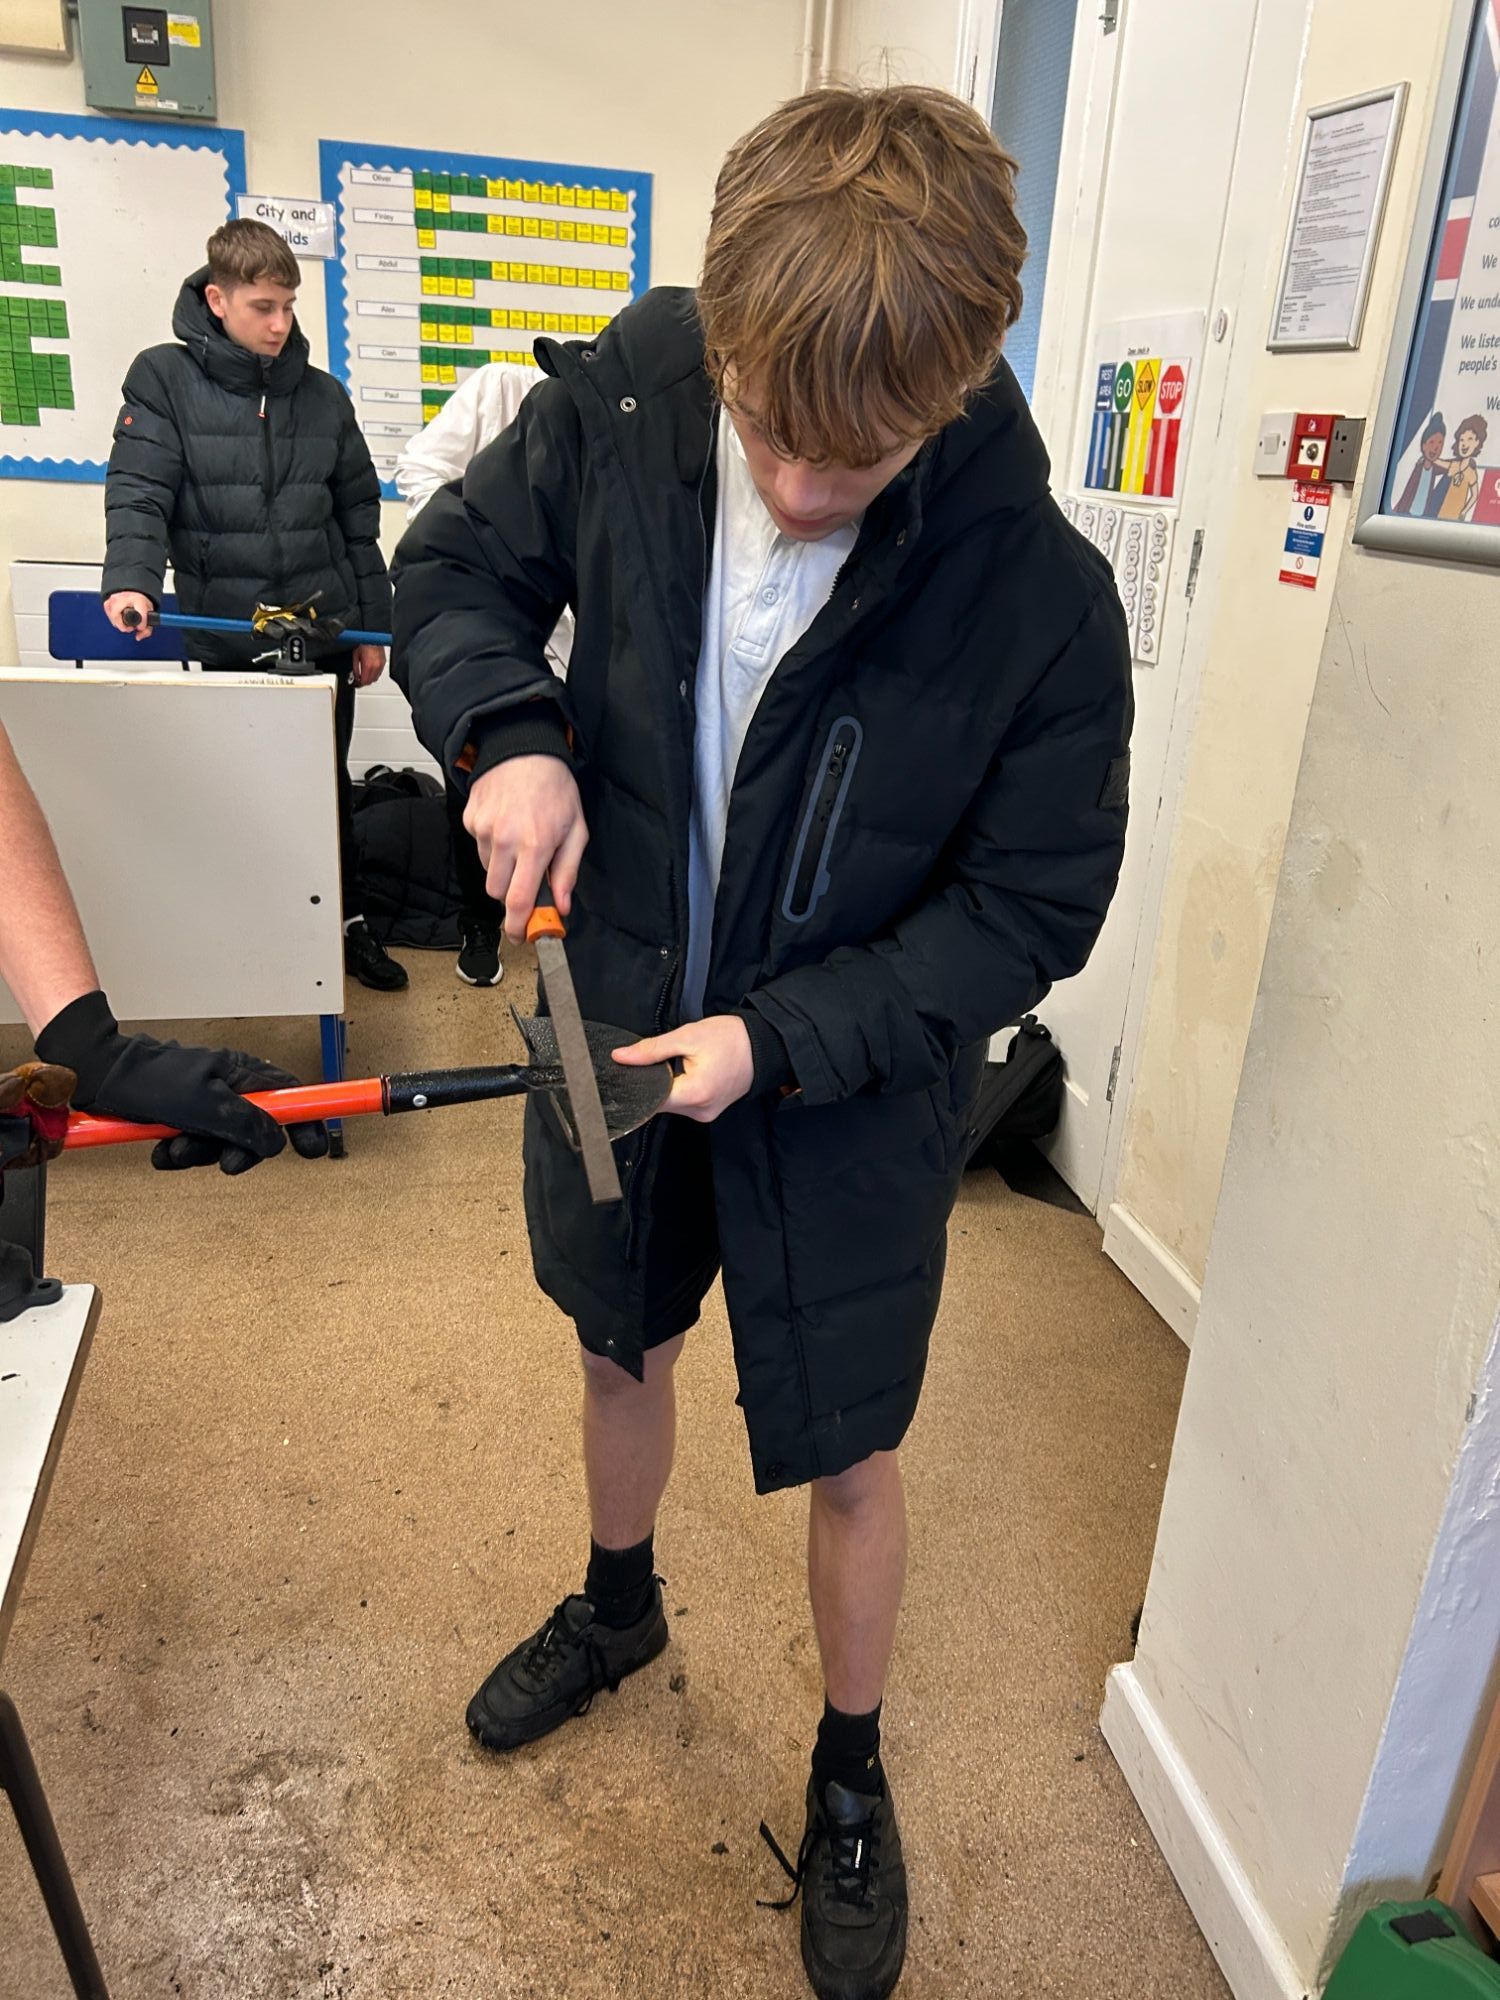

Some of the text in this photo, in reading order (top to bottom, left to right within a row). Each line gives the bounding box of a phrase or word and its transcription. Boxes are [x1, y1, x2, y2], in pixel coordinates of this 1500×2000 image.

[256, 203, 316, 222] City and
[281, 229, 309, 246] ilds
[1482, 253, 1497, 270] We
[1460, 295, 1475, 311] We
[1461, 332, 1500, 350] We liste
[1458, 354, 1497, 376] people's
[1101, 368, 1114, 381] REST
[1116, 378, 1132, 398] GO
[1137, 379, 1153, 394] SLOW
[1160, 381, 1183, 400] STOP
[1487, 395, 1500, 411] We
